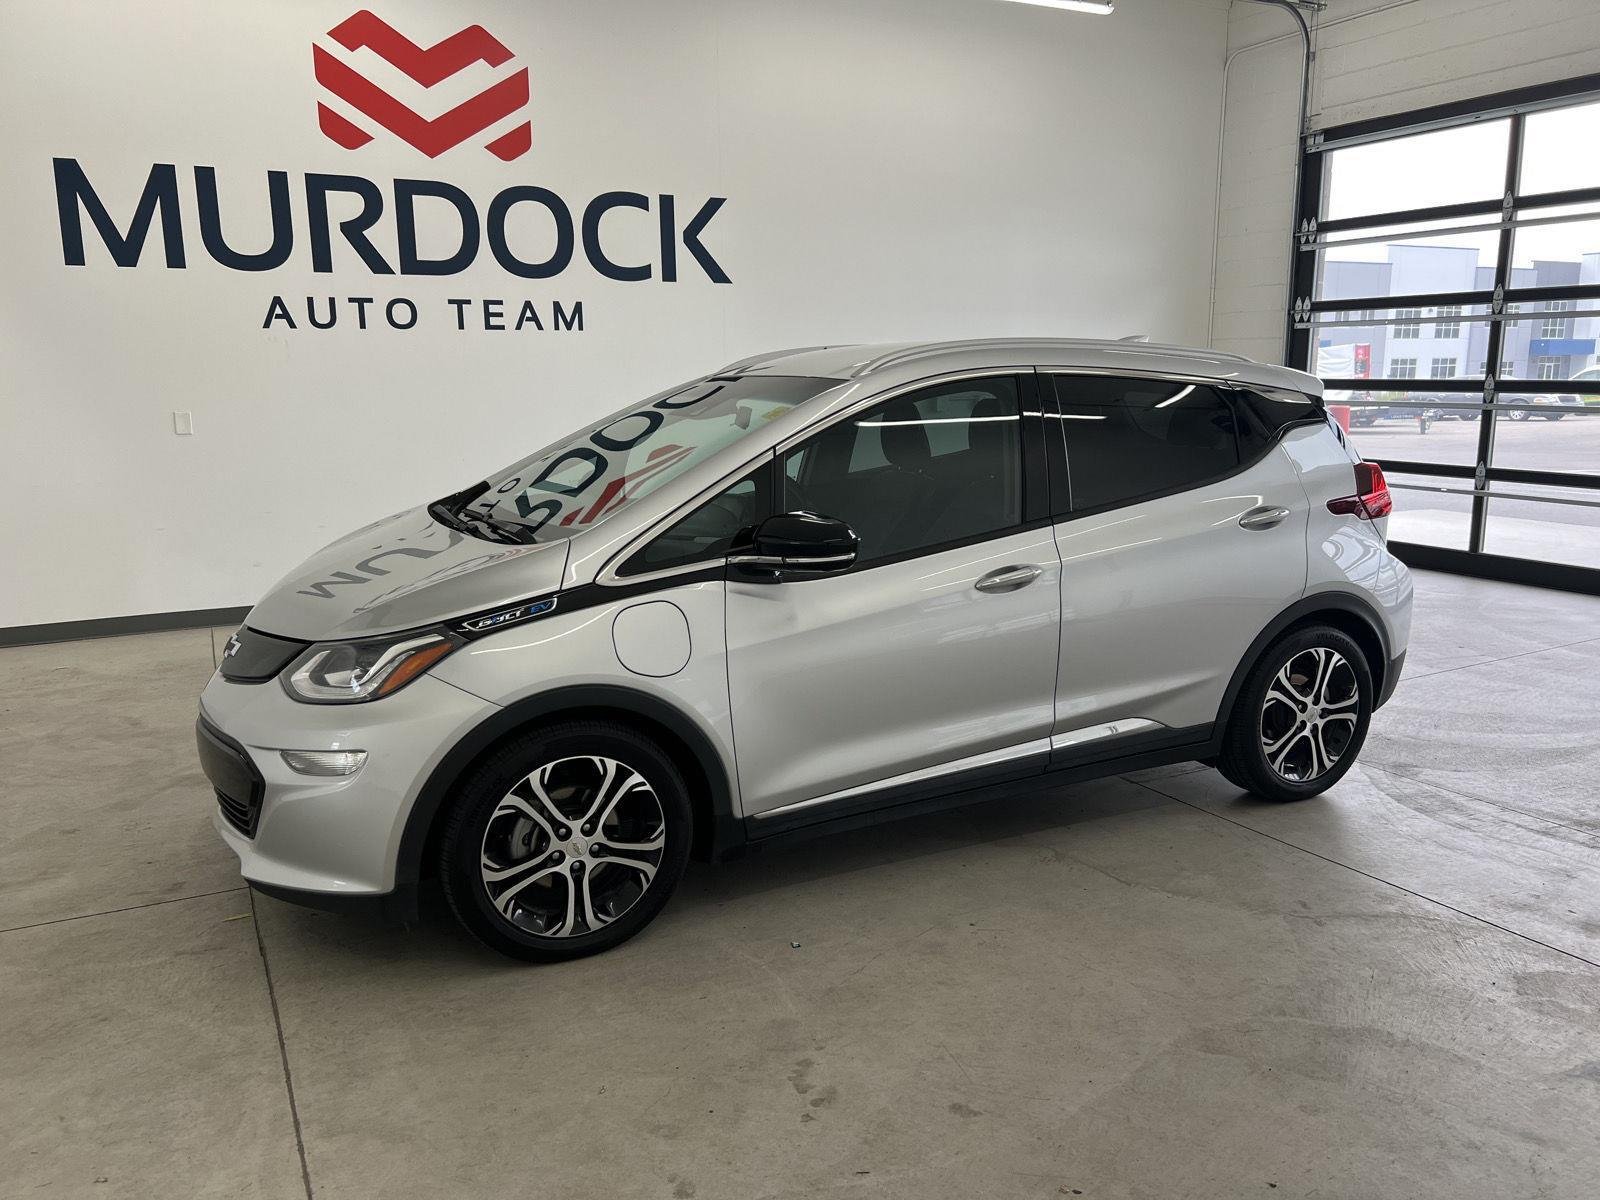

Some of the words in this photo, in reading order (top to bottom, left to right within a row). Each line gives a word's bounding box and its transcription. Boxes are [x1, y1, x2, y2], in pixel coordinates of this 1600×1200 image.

[53, 157, 732, 285] MURDOCK
[263, 295, 418, 330] AUTO
[448, 298, 584, 332] TEAM
[531, 602, 551, 614] EV
